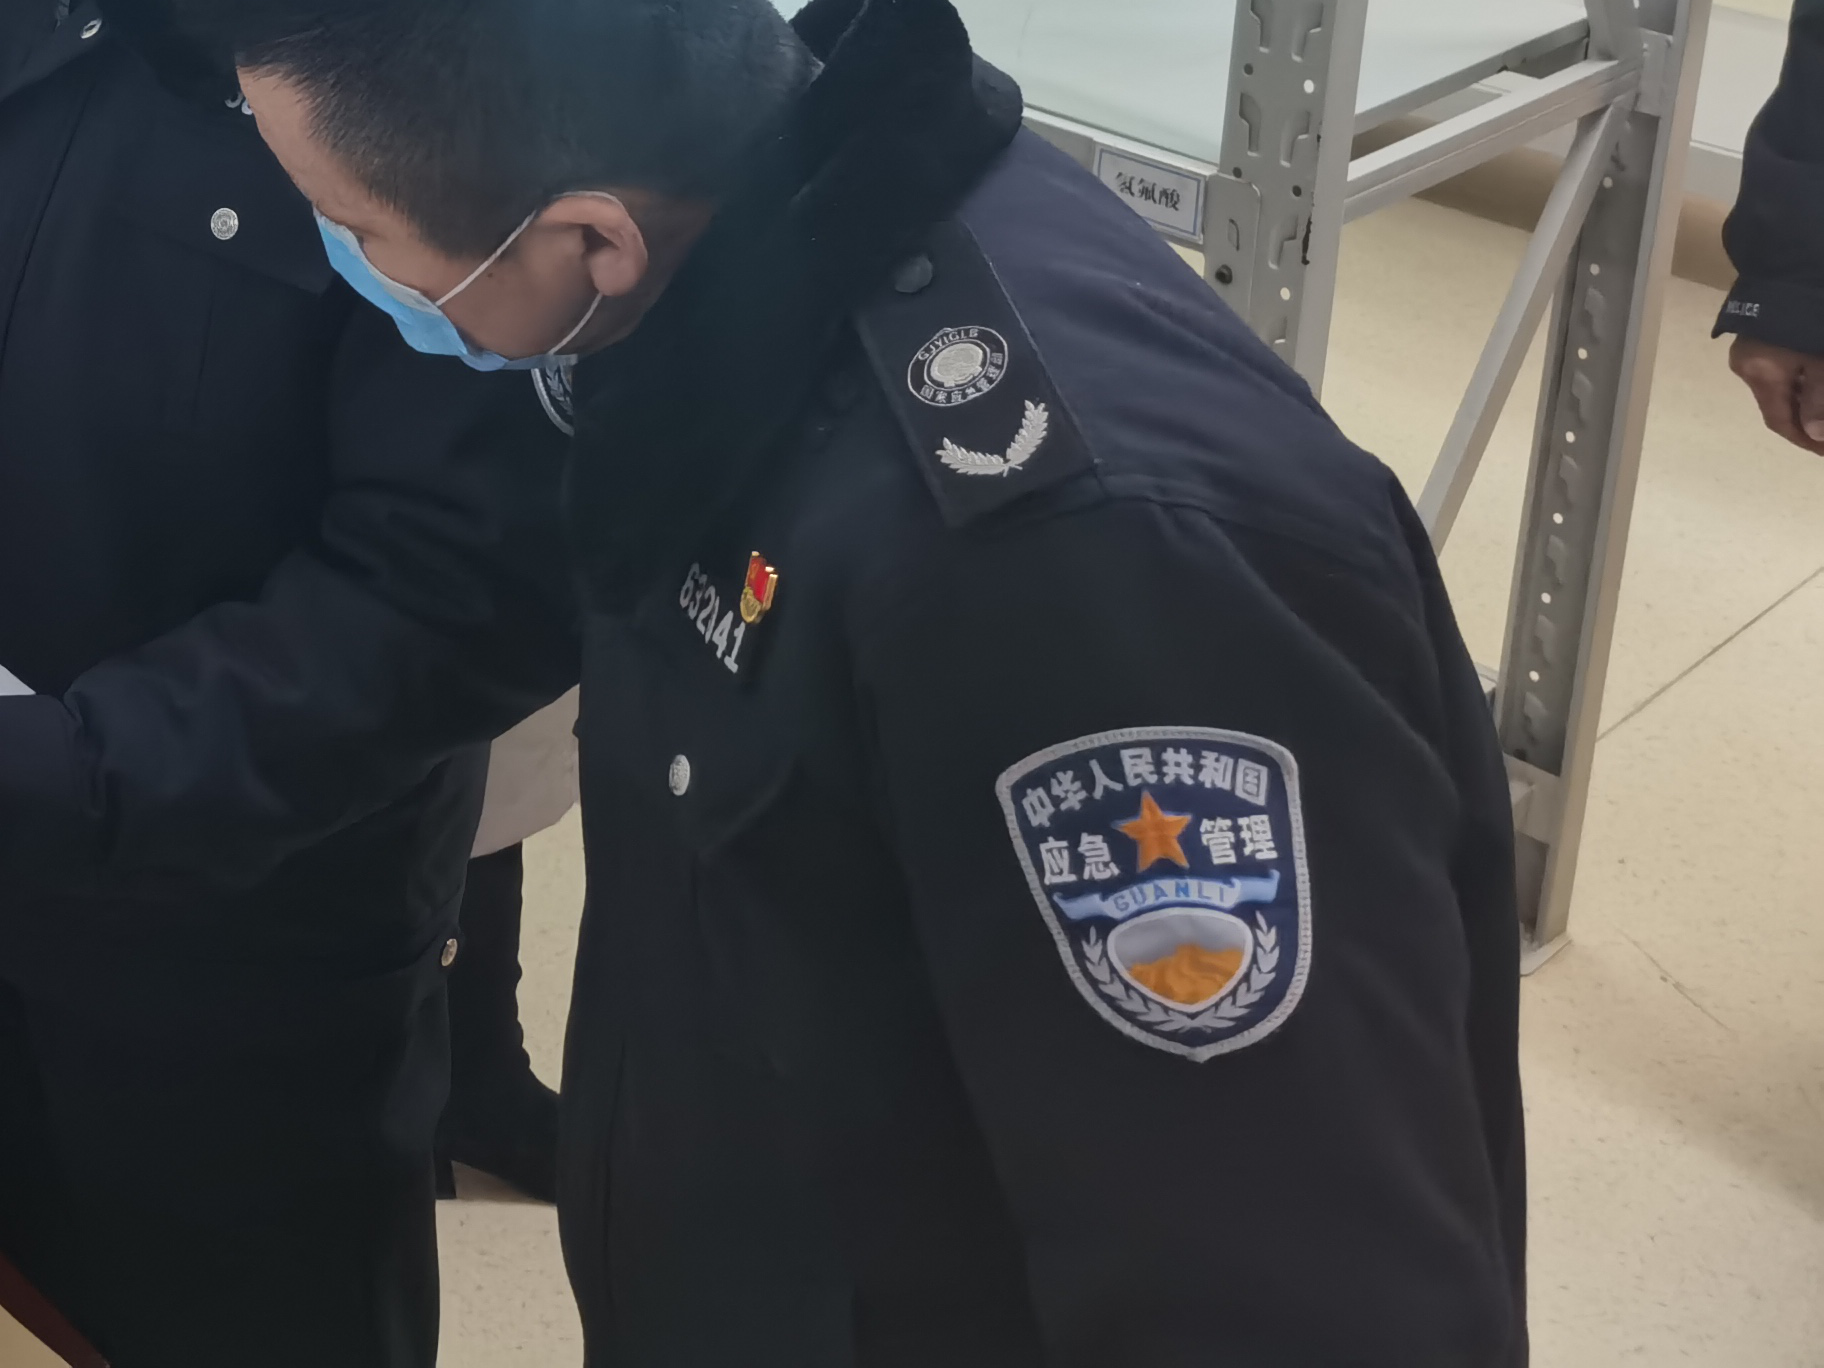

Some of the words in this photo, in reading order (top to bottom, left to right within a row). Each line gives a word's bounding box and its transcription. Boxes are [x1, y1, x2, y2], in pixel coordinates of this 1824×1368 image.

[1021, 746, 1269, 828] 中华人民共和国
[1039, 832, 1121, 886] 应急
[1199, 814, 1278, 866] 管理
[1113, 882, 1226, 912] GUANLI
